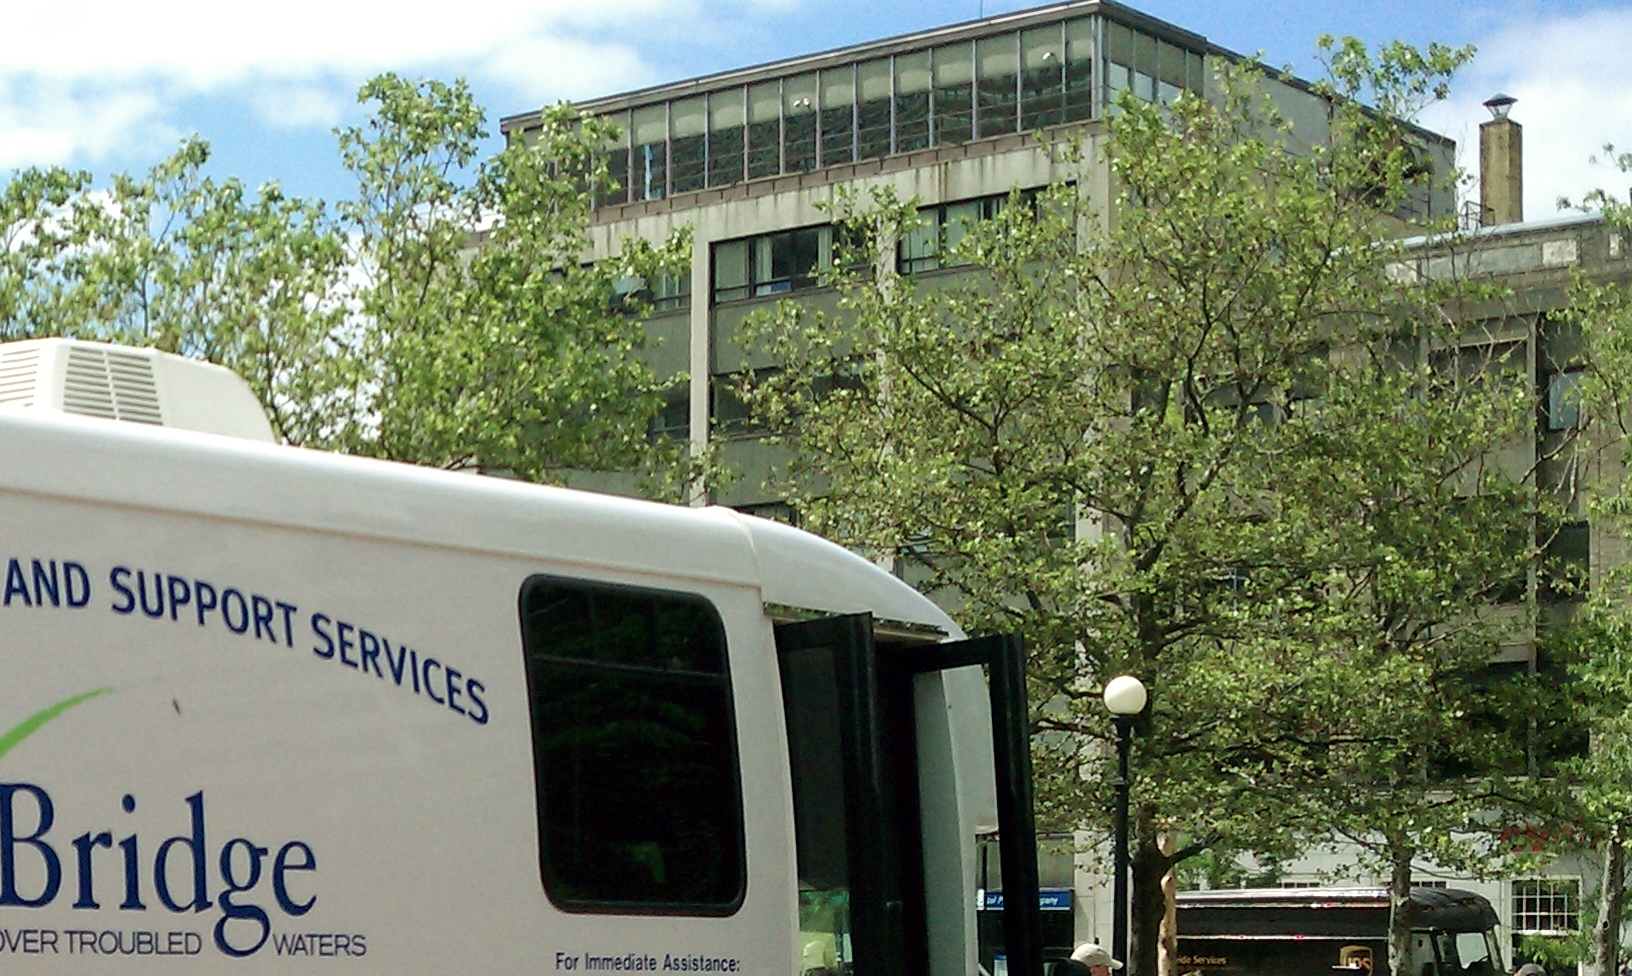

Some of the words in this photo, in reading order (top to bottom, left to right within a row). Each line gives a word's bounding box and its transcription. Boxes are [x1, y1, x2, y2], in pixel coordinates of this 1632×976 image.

[3, 557, 91, 609] AND
[109, 565, 298, 648] SUPPORT
[310, 611, 490, 726] SERVICES
[63, 931, 202, 956] TROUBLED
[272, 934, 367, 957] WATERS
[555, 952, 579, 971] For
[585, 953, 657, 971] Immediate
[663, 954, 741, 972] Assistance:
